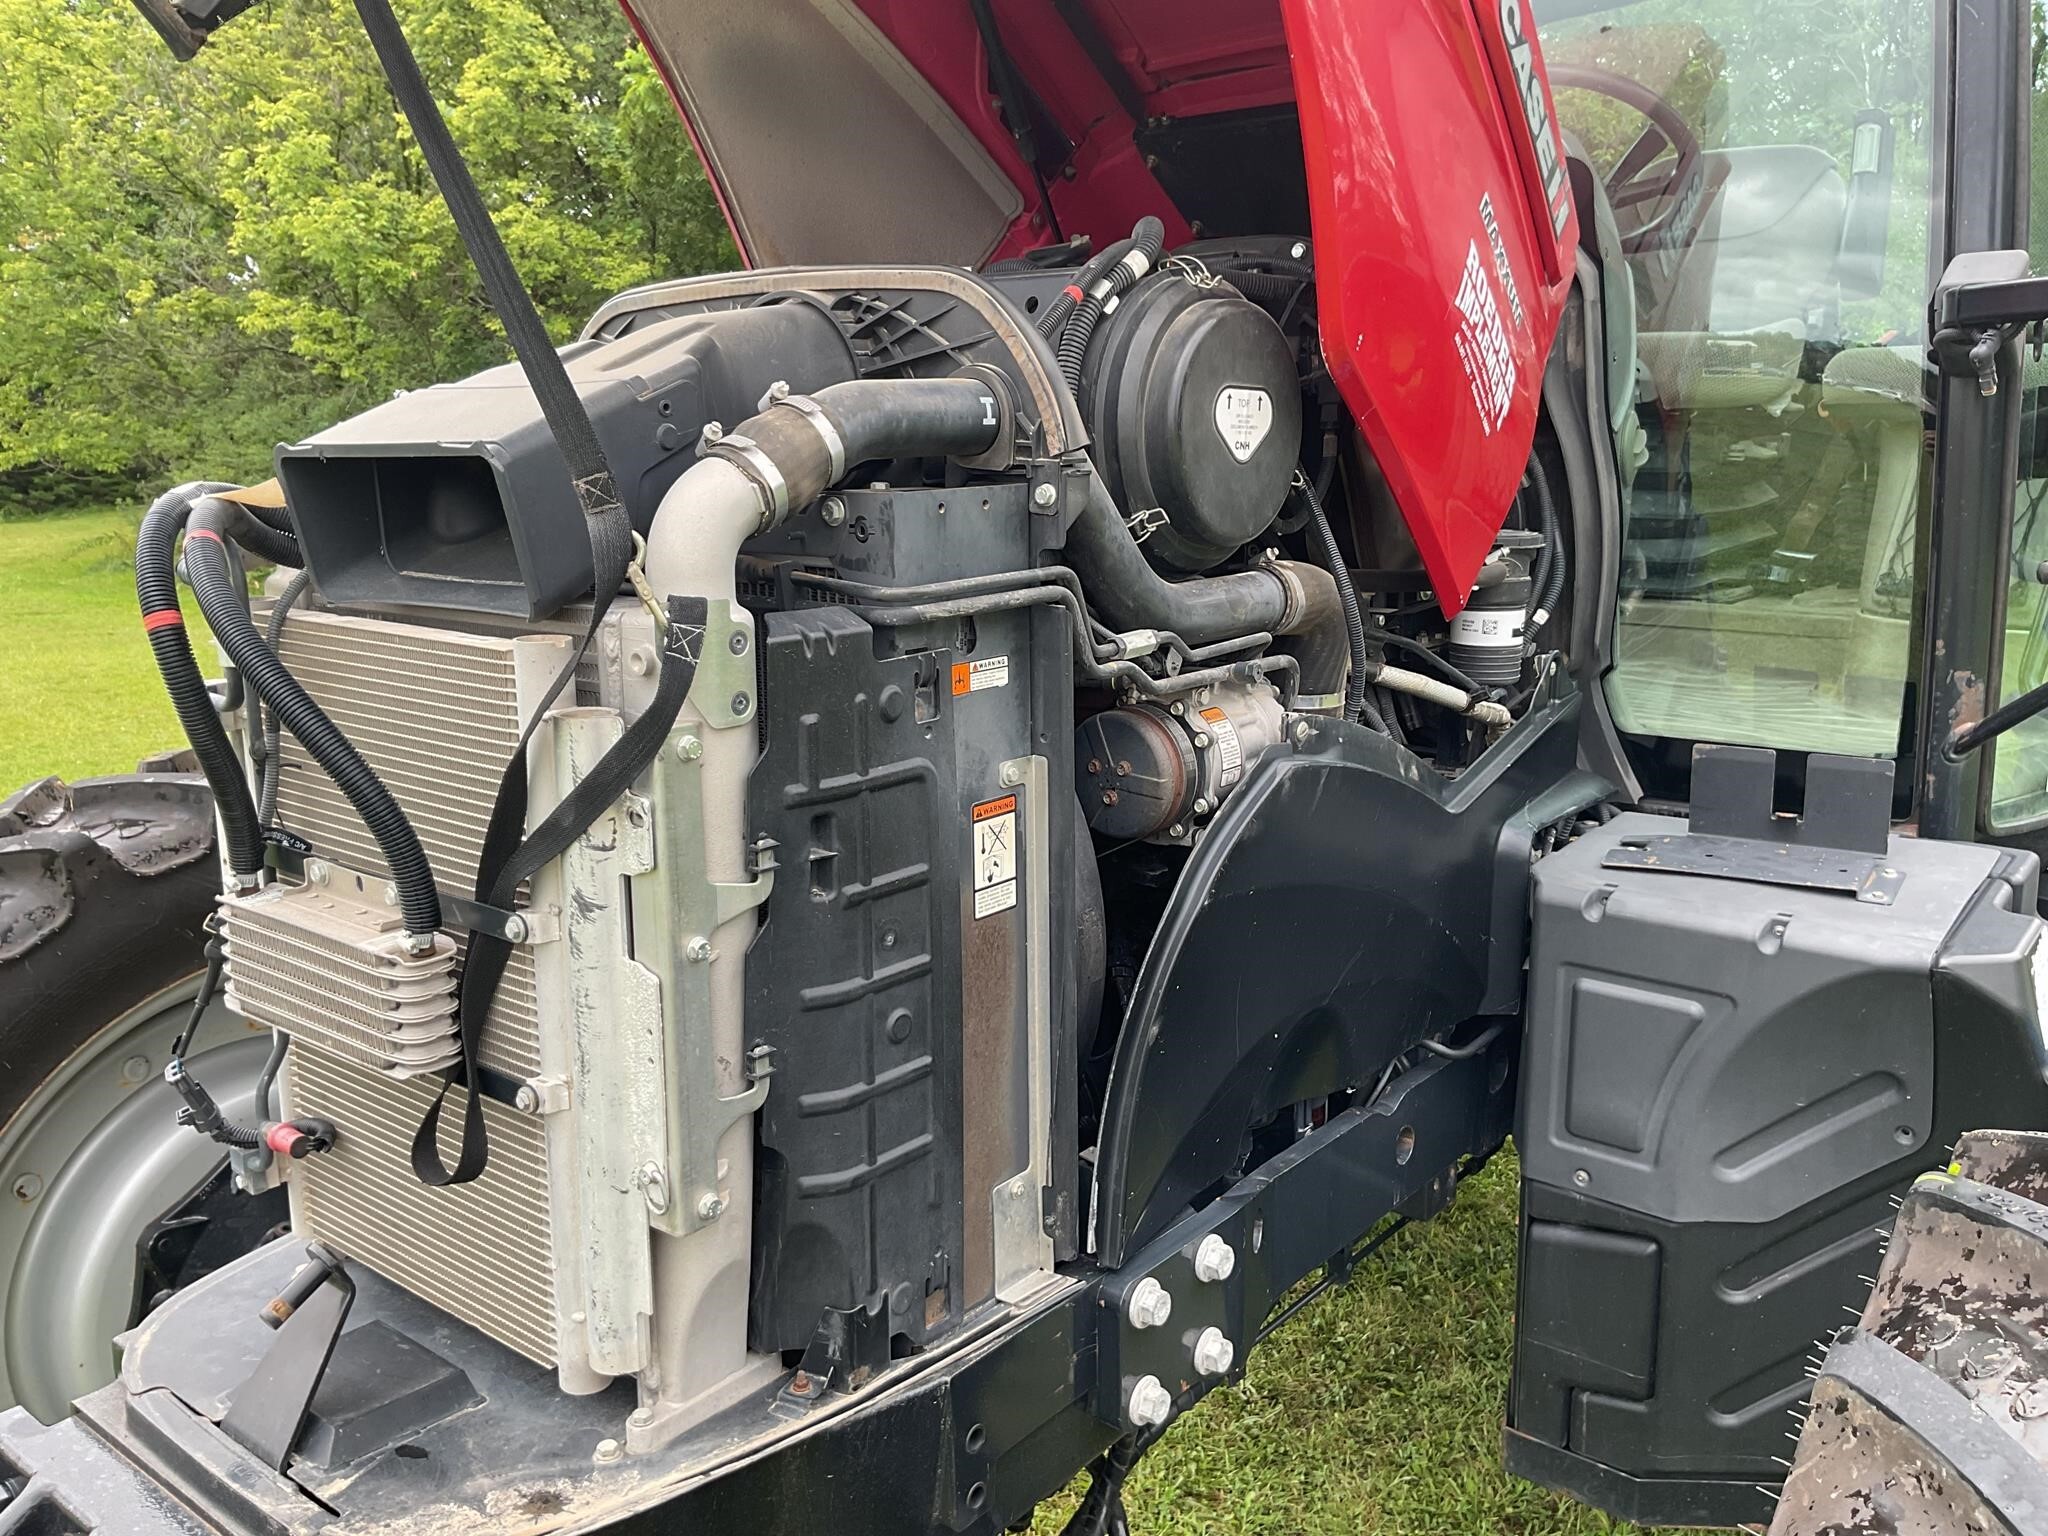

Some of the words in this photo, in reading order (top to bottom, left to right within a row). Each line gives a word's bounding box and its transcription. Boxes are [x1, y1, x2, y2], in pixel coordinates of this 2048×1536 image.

[1500, 0, 1557, 180] CASE
[1466, 237, 1517, 400] ROEDER
[1479, 191, 1523, 331] MAXXUM
[1454, 267, 1511, 432] IMPLEMENT
[1235, 441, 1250, 450] CNH
[978, 658, 1005, 669] WARNING
[983, 800, 1014, 815] WARNING
